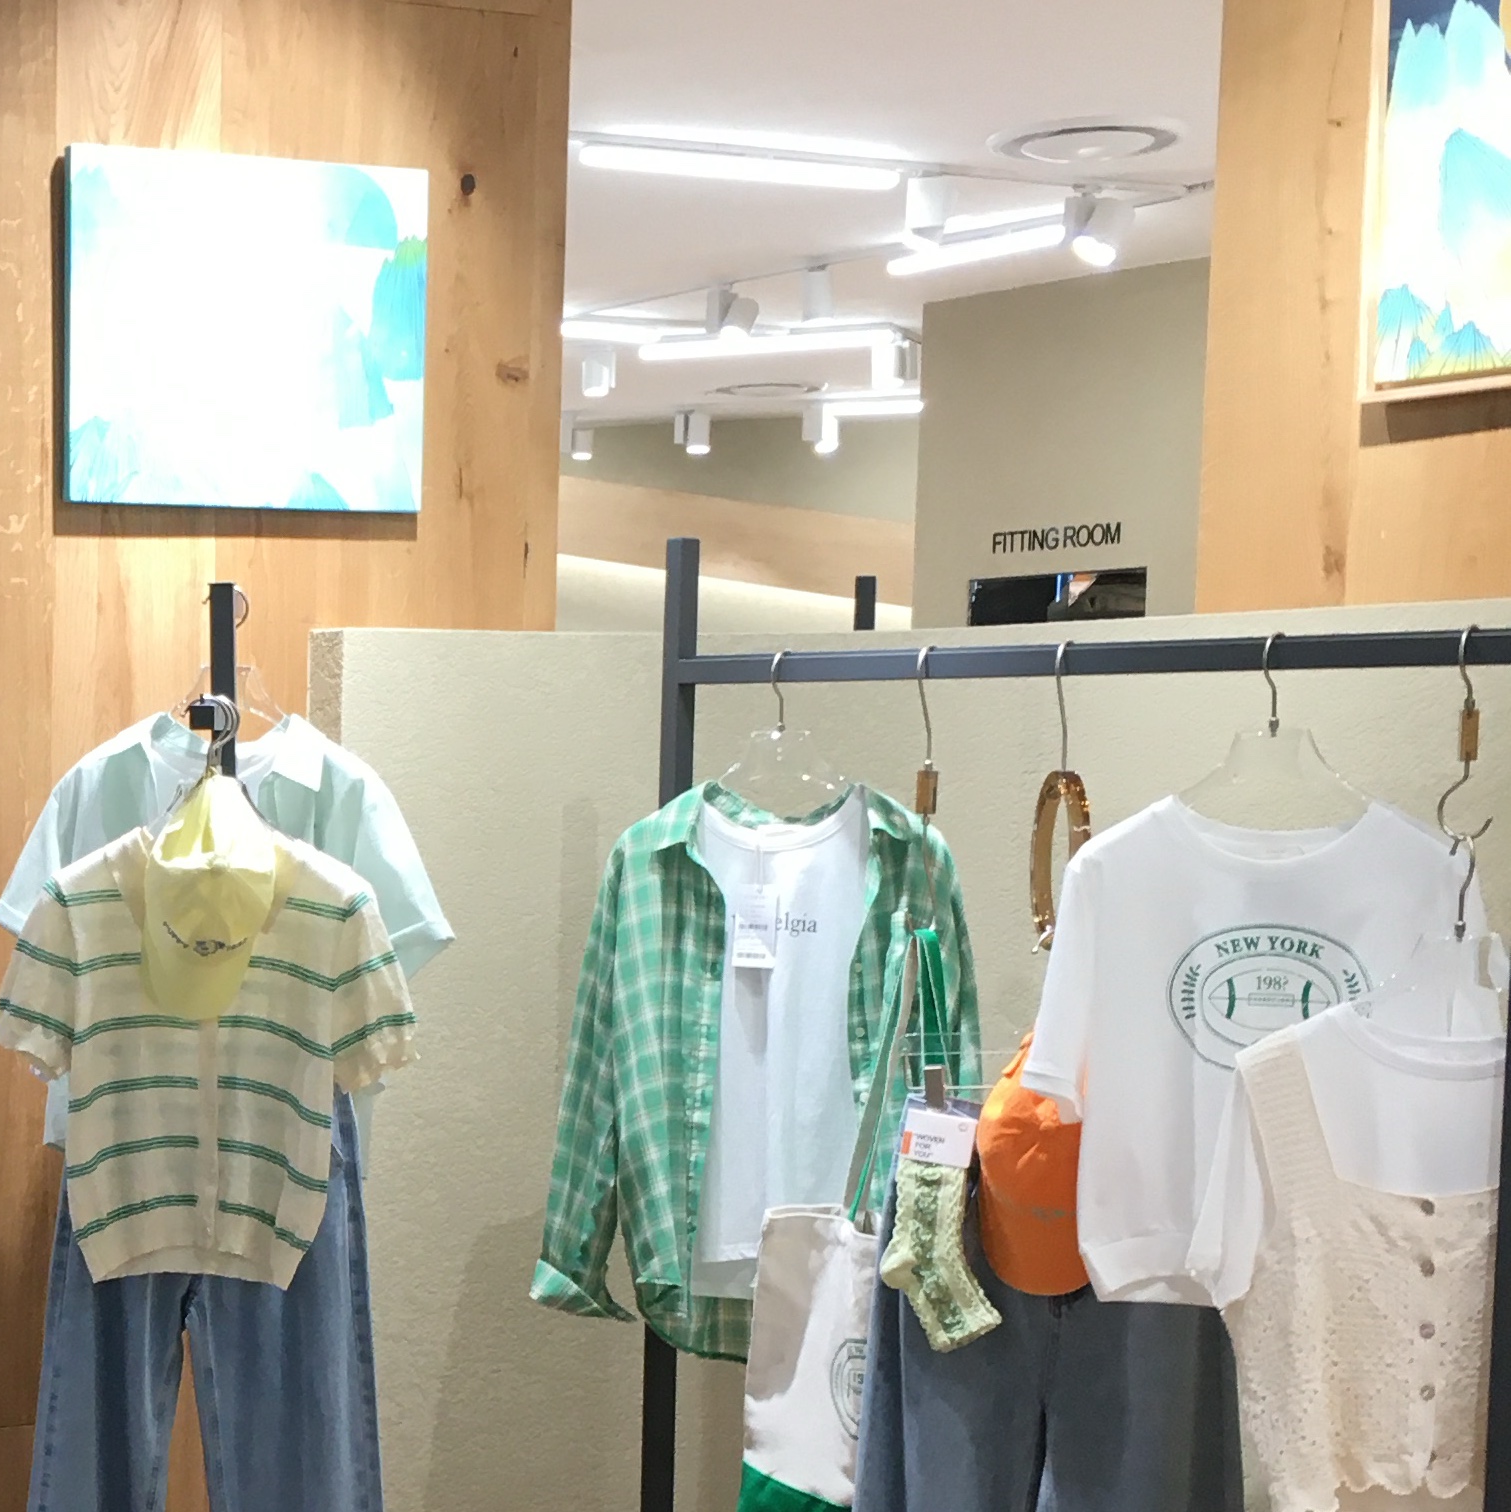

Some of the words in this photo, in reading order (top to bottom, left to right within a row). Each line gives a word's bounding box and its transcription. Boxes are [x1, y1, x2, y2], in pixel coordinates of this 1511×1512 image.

[992, 527, 1059, 554] FITTING
[1063, 522, 1122, 549] ROOM
[1214, 936, 1261, 958] NEW
[1267, 936, 1325, 960] YORK
